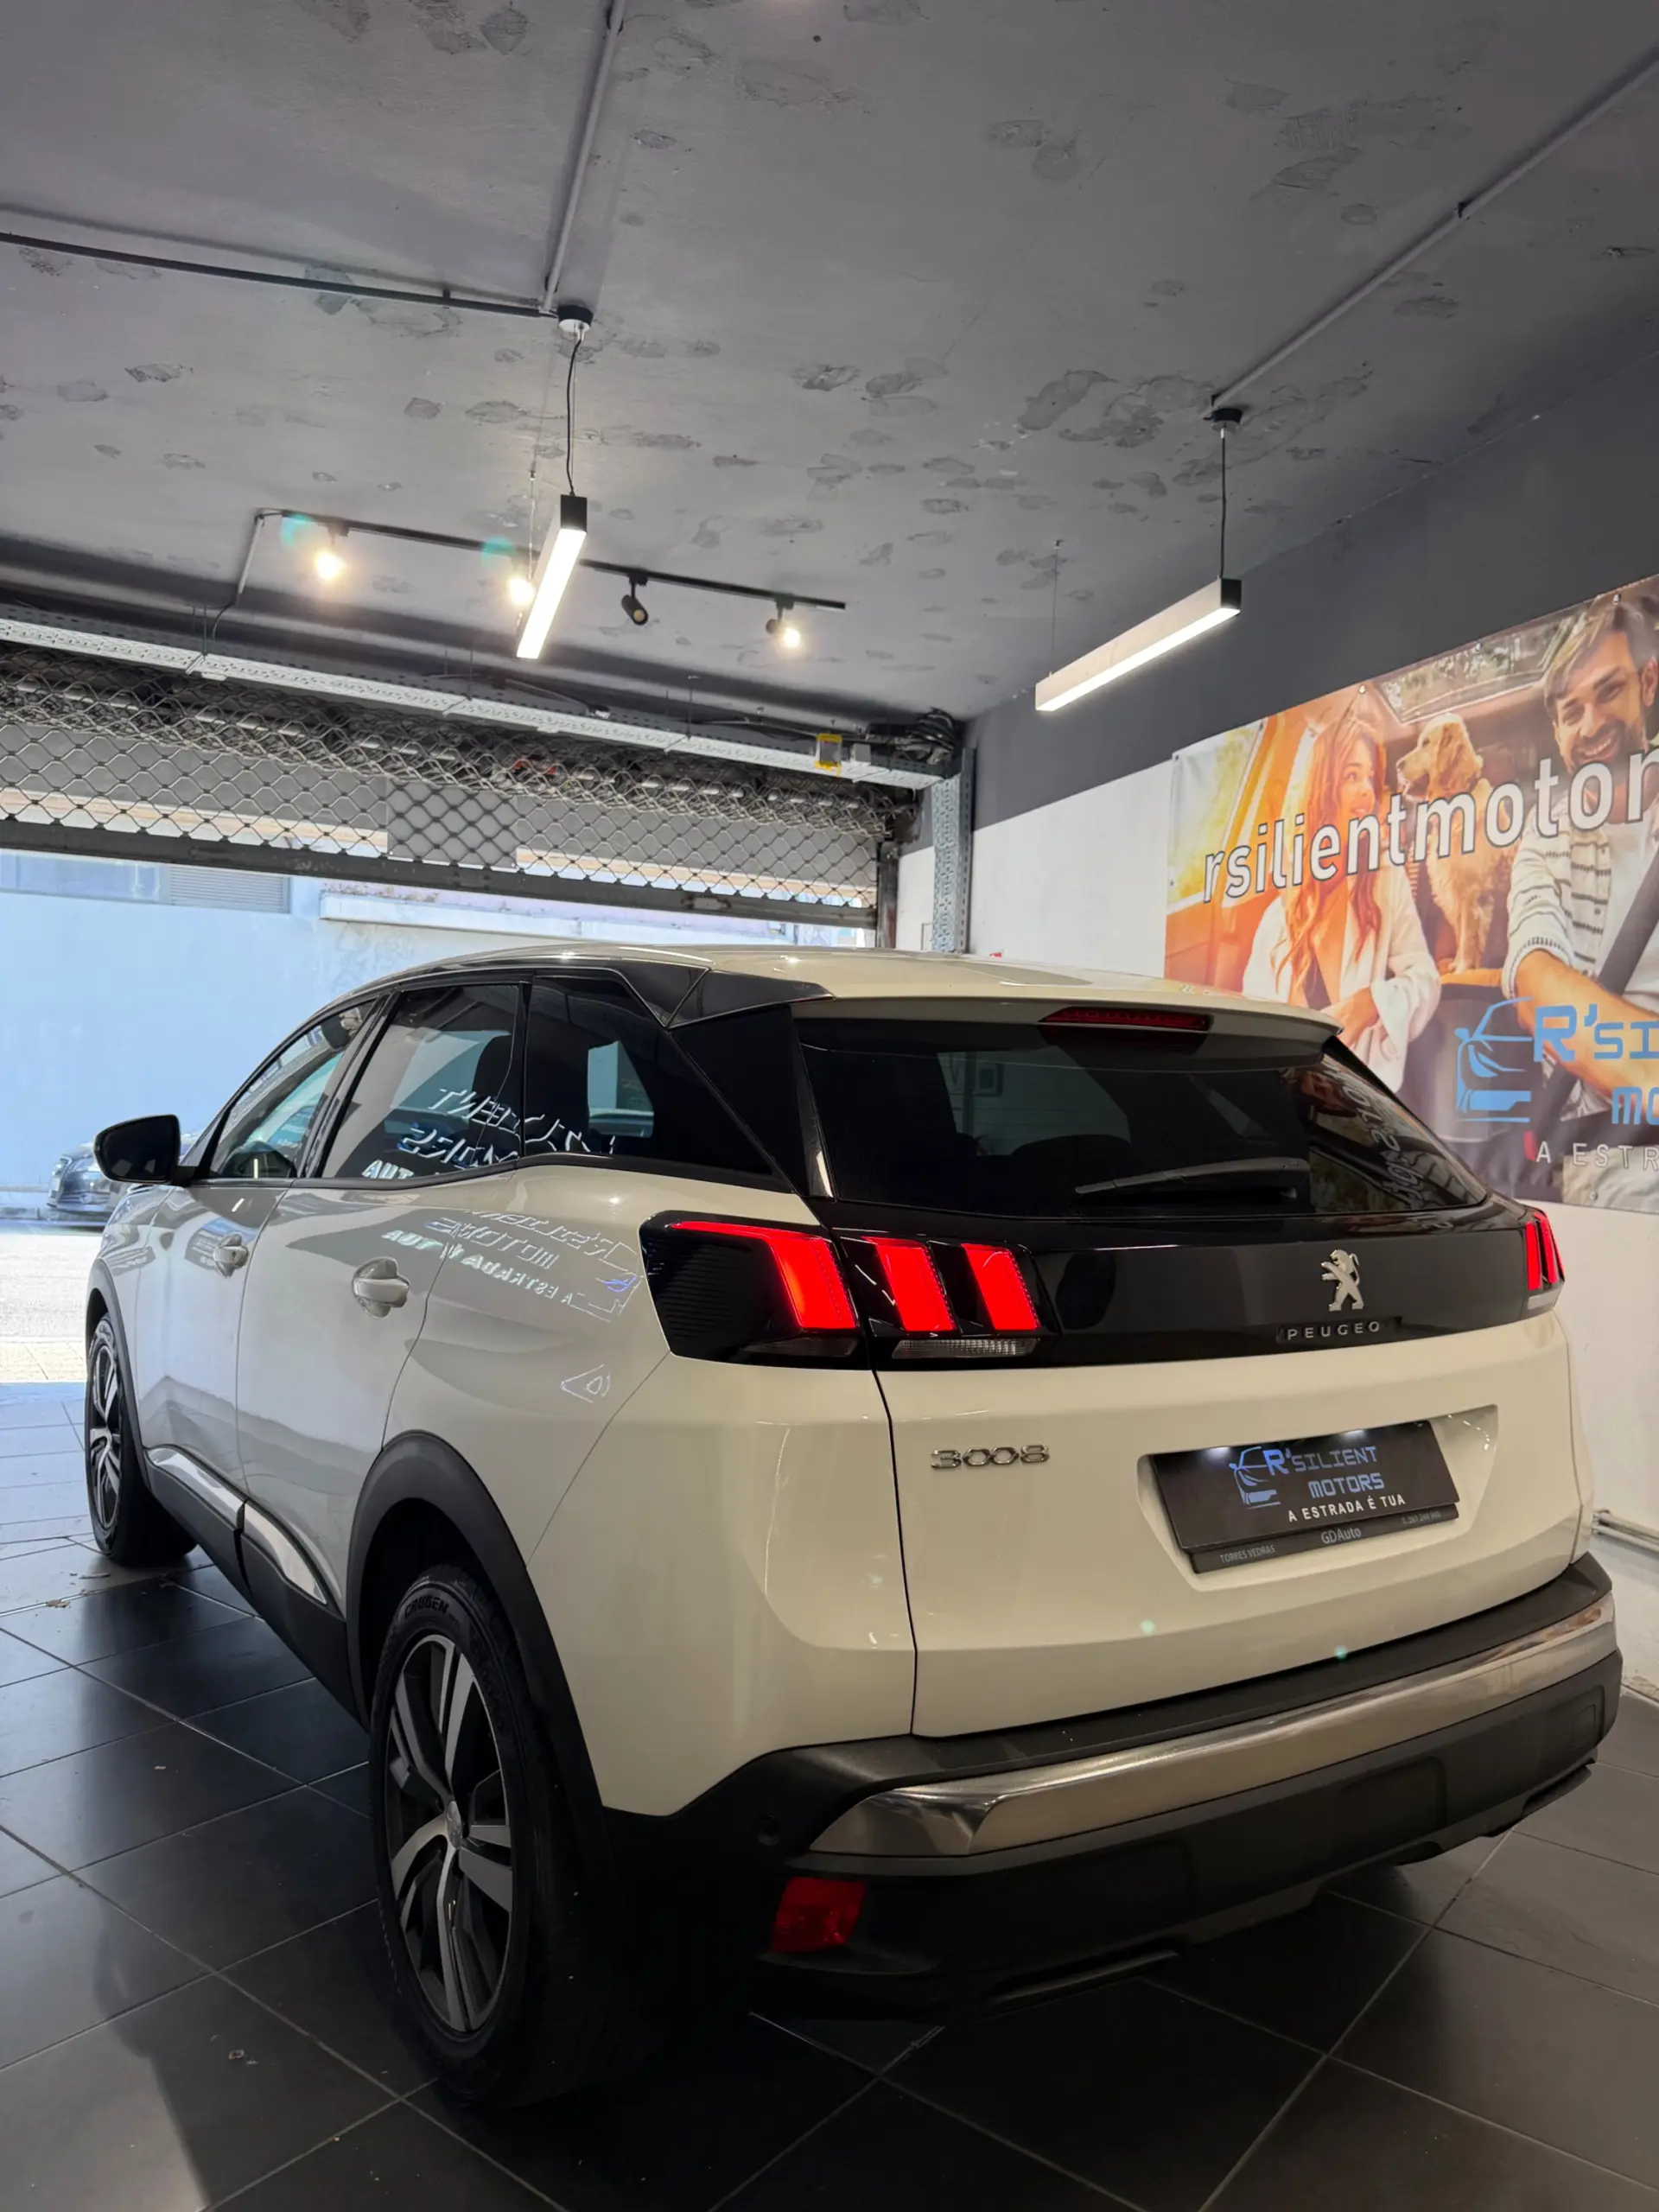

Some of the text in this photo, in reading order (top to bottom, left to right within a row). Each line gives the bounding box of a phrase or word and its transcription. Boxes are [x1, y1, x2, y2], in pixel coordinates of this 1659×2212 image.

[1535, 1141, 1659, 1172] A ESTR
[930, 1443, 1050, 1470] 3008
[1263, 1446, 1378, 1476] R'SILIENT
[1307, 1472, 1385, 1499] MOTORS
[1288, 1493, 1407, 1522] A ESTRADA É TUA
[1320, 1527, 1362, 1545] GDAuto
